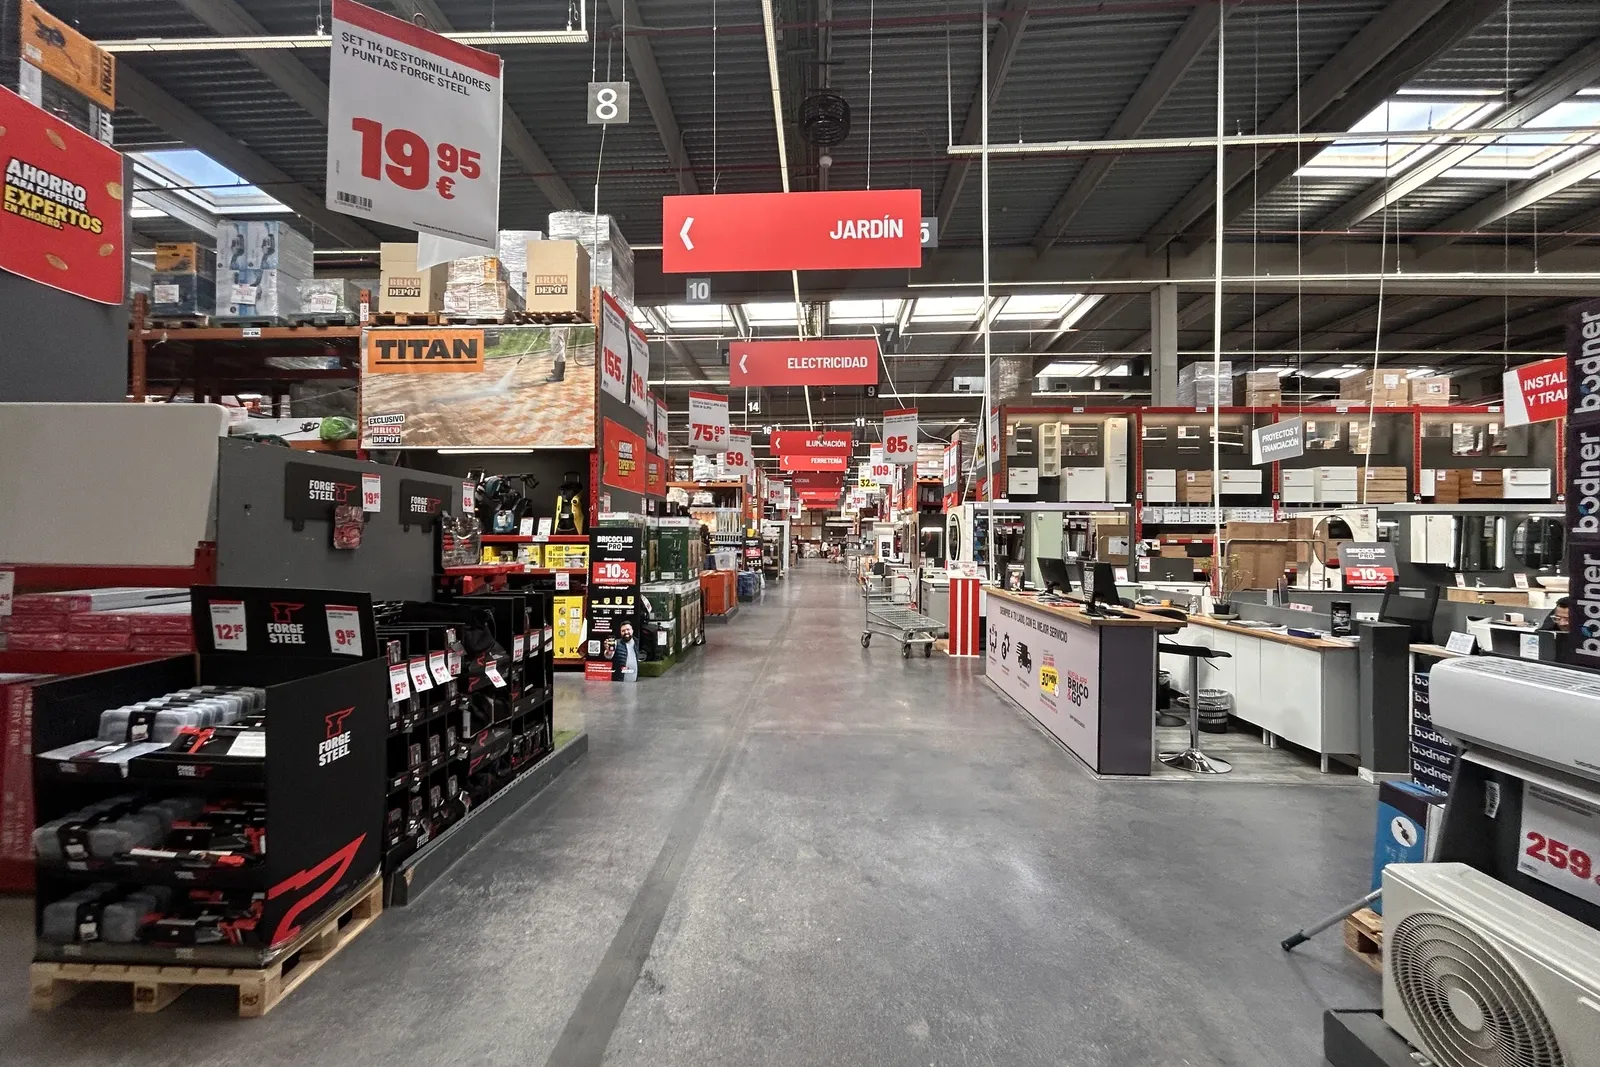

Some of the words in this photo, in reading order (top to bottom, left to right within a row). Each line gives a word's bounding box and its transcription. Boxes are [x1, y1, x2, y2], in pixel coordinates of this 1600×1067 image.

[342, 32, 364, 45] SET
[367, 40, 383, 54] 114
[386, 46, 491, 92] DESTORNILLADORES
[341, 45, 350, 55] Y
[352, 48, 398, 71] PUNTAS
[401, 65, 435, 84] FORGE
[437, 77, 470, 96] STEEL
[595, 88, 618, 120] 8
[352, 117, 430, 191] 19
[437, 143, 481, 179] 95
[7, 158, 87, 203] AHORRO
[436, 176, 456, 200] €
[6, 174, 34, 192] PARA
[36, 184, 88, 213] EXPERTOS.
[4, 184, 103, 234] EXPERTOS
[4, 201, 18, 216] EN
[20, 207, 64, 230] AHORRO.
[829, 214, 904, 240] JARDÍN
[388, 278, 421, 287] BRICO
[535, 275, 568, 285] BRICO
[388, 286, 421, 297] DEPÔT
[535, 284, 568, 295] DEPÔT
[689, 282, 709, 300] 10
[886, 328, 894, 341] 7
[375, 338, 478, 359] TITAN
[604, 346, 622, 382] 155
[787, 356, 869, 369] ELECTRICIDAD
[868, 386, 875, 397] 9
[748, 402, 759, 412] 14
[1527, 395, 1536, 407] Y
[369, 414, 404, 425] EXCLUSIVO
[856, 418, 865, 427] 11
[373, 426, 400, 435] BRICO
[692, 424, 713, 441] 75
[714, 427, 725, 435] 95
[762, 426, 772, 435] 16
[1262, 428, 1293, 443] PROYECTOS
[1294, 426, 1299, 435] Y
[373, 434, 400, 444] DEPÔT
[886, 436, 908, 453] 85
[1262, 437, 1299, 453] FINANCIACIÓN
[726, 452, 744, 467] 59
[811, 456, 842, 464] FERRETERÍA
[872, 465, 889, 476] 109
[309, 480, 335, 491] FORGE
[1572, 432, 1600, 534] bodner
[309, 490, 335, 501] STEEL
[364, 492, 374, 505] 19
[410, 496, 428, 506] FORGE
[410, 504, 428, 513] STEEL
[598, 564, 630, 579] -10%
[1576, 554, 1600, 657] bodner
[215, 624, 233, 640] 12
[267, 623, 305, 634] FORGE
[1037, 621, 1049, 635] MEJOR
[1050, 626, 1068, 643] SERVICIO
[270, 634, 306, 645] STEEL
[335, 629, 346, 646] 9
[416, 675, 422, 685] 5
[1042, 673, 1049, 686] 30
[395, 684, 401, 695] 5
[1068, 677, 1089, 699] BRICO
[1072, 692, 1081, 707] GO
[319, 731, 351, 755] FORGE
[319, 744, 351, 766] STEEL
[1412, 743, 1451, 765] bodner
[1414, 760, 1452, 782] bodner
[1526, 832, 1593, 880] 259
